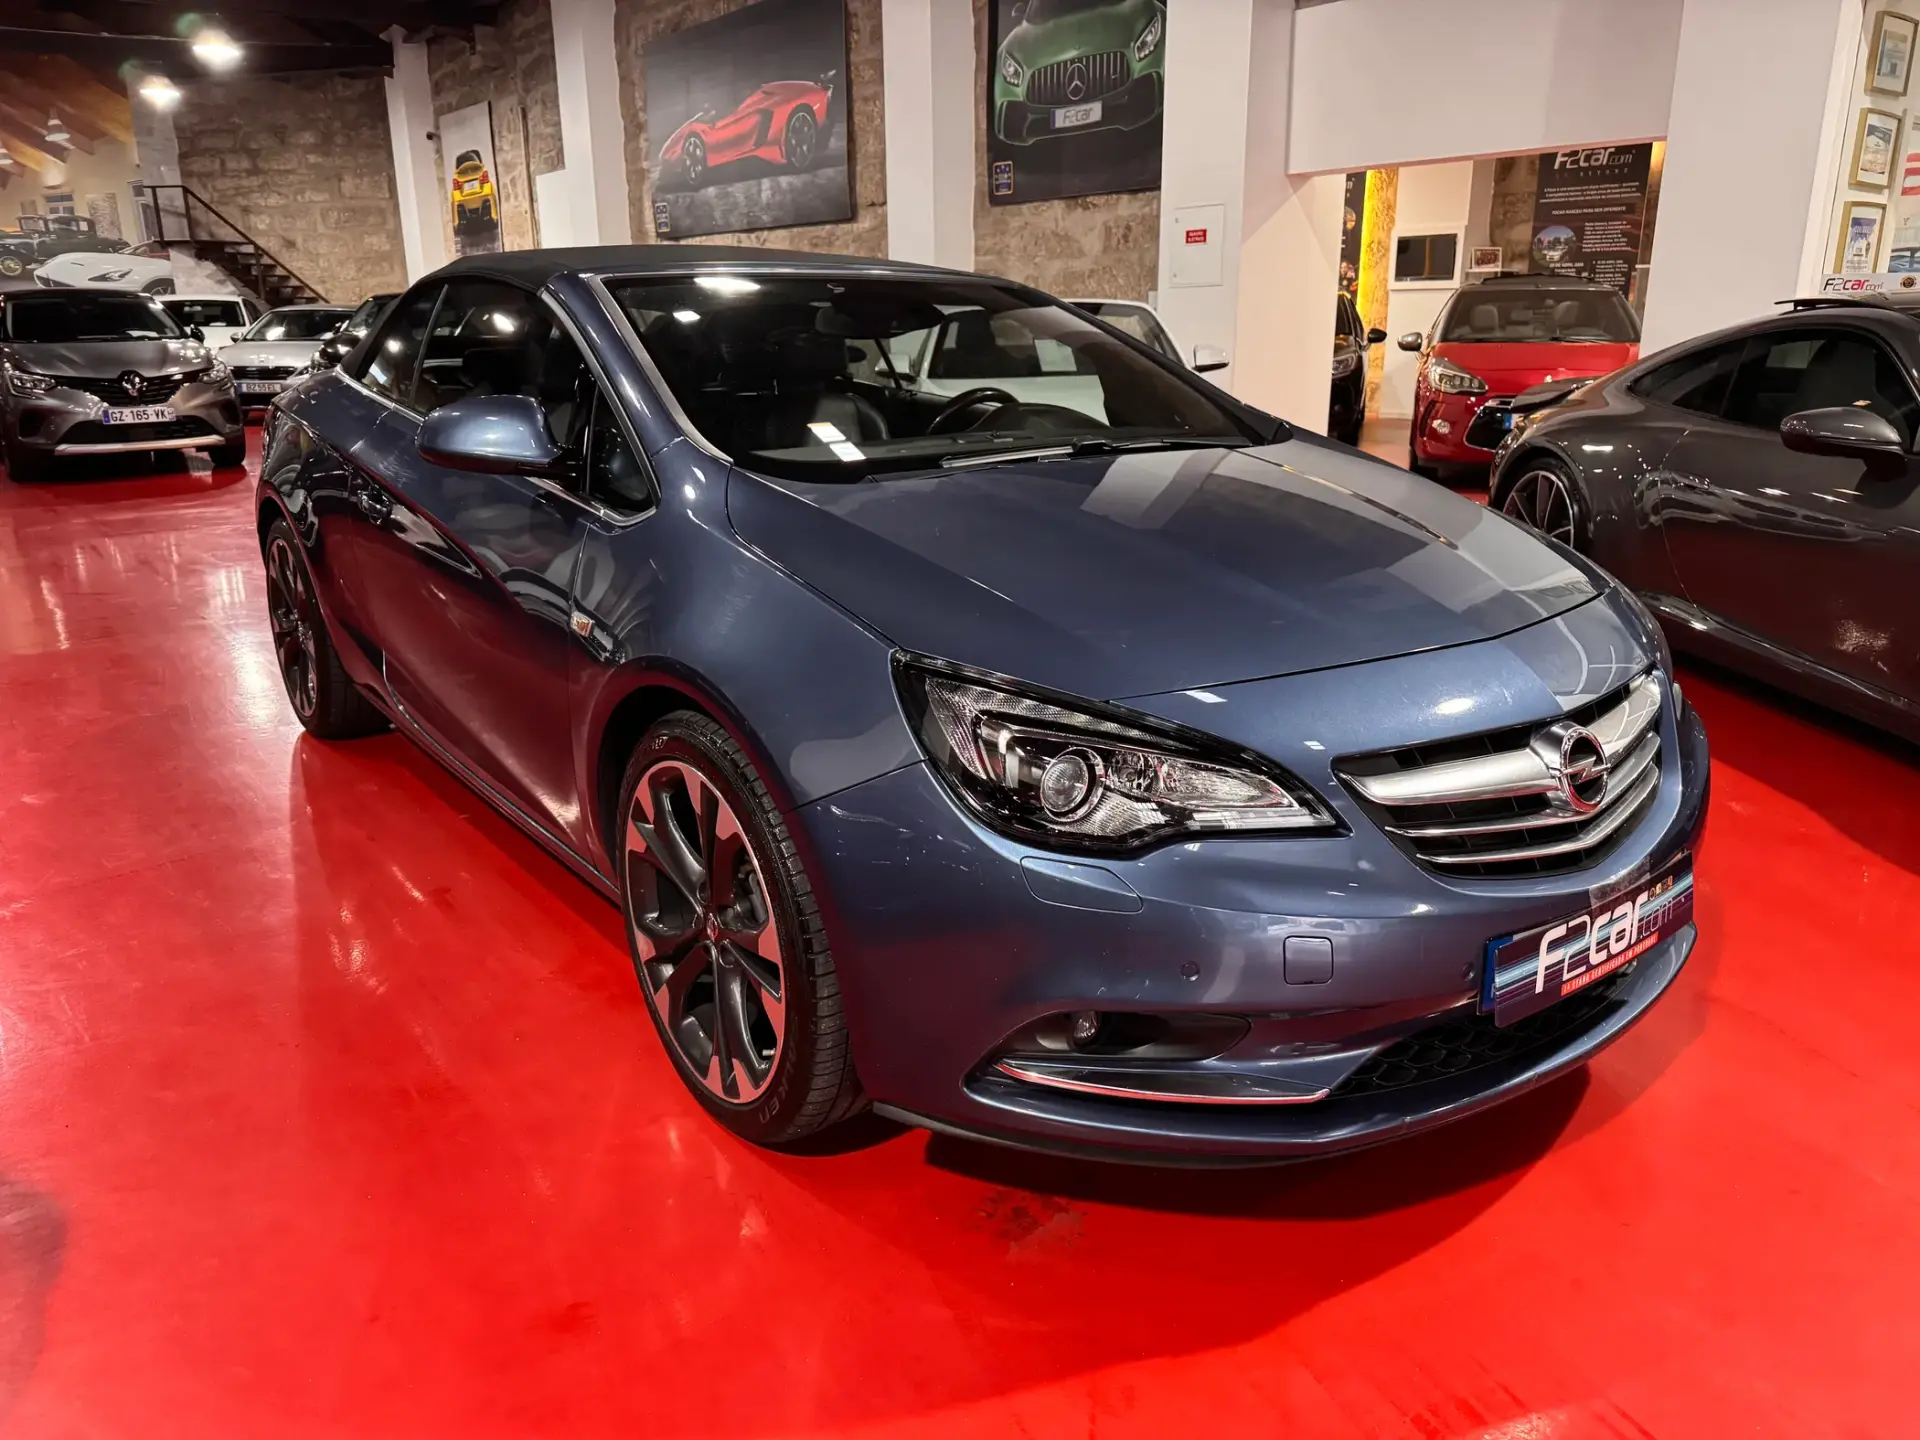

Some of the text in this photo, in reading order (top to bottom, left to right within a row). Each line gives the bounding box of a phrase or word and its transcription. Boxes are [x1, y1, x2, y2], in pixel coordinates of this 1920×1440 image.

[1823, 277, 1883, 291] F2car.com
[110, 408, 168, 423] GZ-165-VK
[1535, 890, 1674, 995] F2car.com
